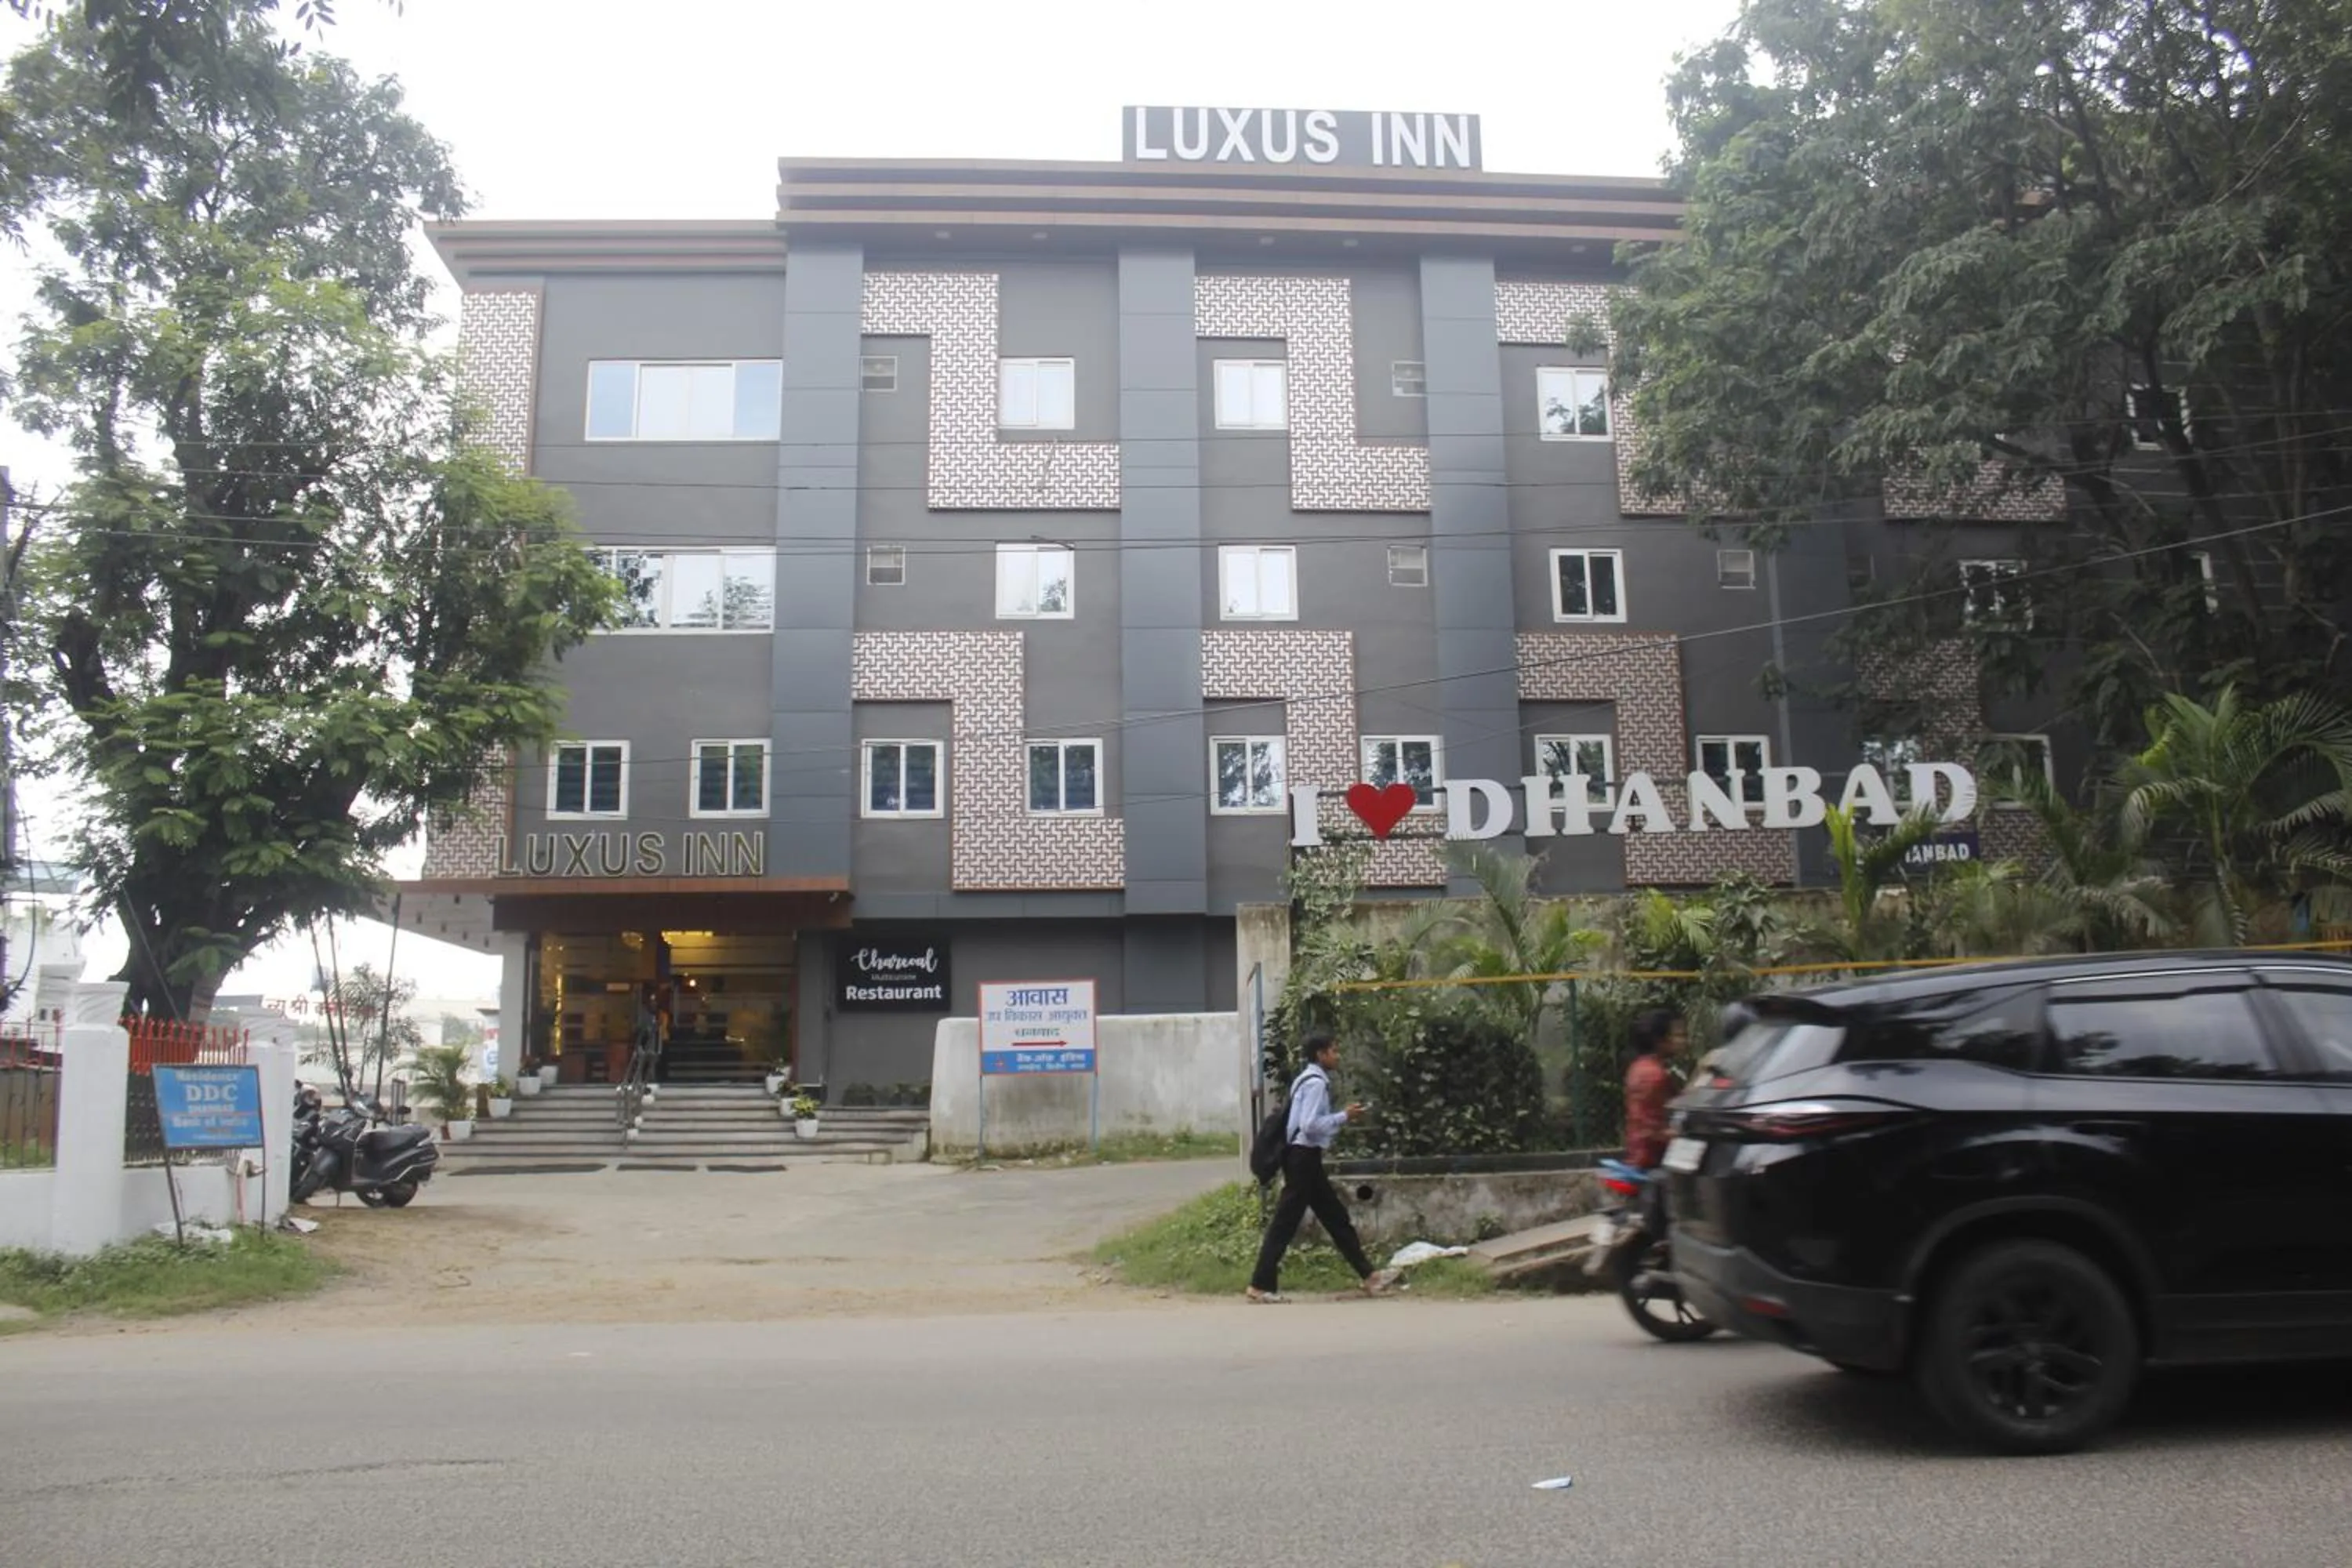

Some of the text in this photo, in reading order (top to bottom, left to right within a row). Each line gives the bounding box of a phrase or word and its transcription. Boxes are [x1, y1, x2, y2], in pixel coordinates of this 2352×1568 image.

[1136, 107, 1471, 167] LUXUS INN
[1291, 763, 1978, 846] I DHANBAD
[497, 830, 764, 877] LUXUS INN
[850, 947, 938, 973] Charcoal
[846, 985, 942, 1000] Restaurant
[1005, 988, 1069, 1007] आवास
[186, 1083, 238, 1102] DDC
